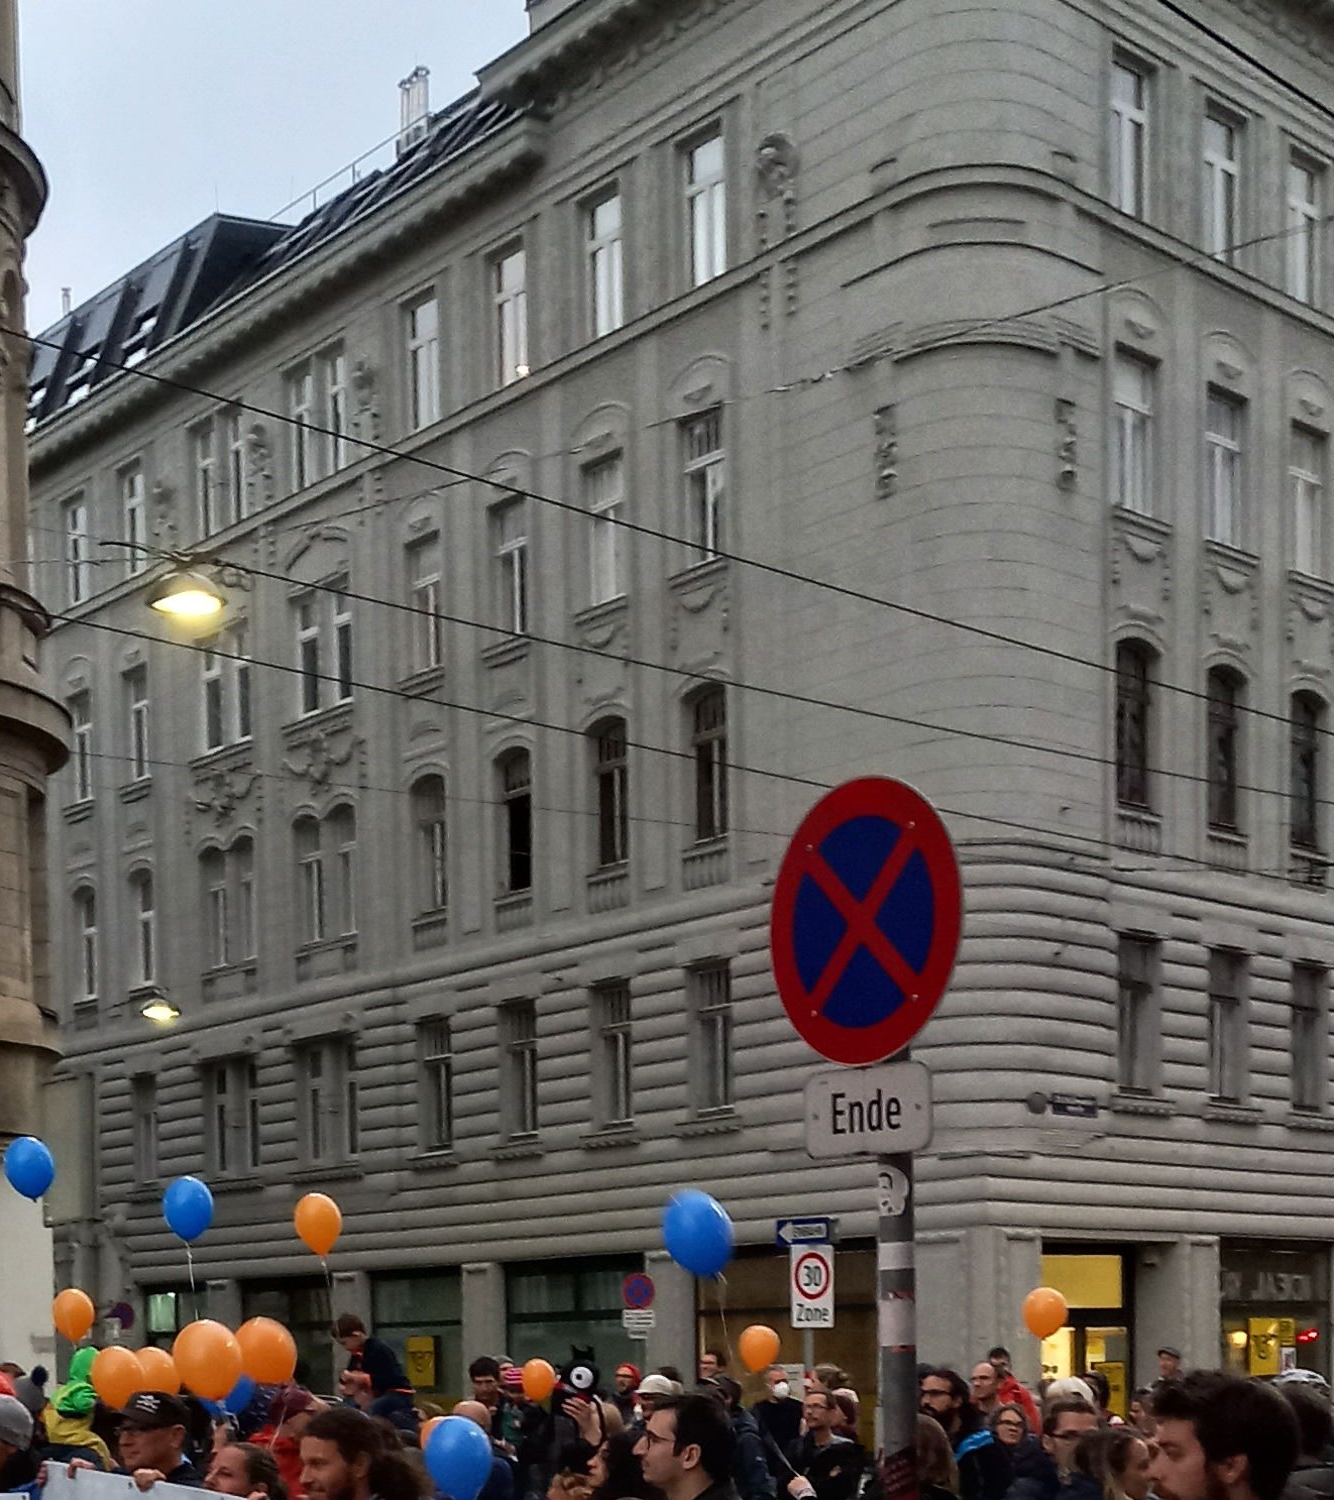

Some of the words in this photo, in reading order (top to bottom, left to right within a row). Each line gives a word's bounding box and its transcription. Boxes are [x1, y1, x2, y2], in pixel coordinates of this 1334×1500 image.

[831, 1087, 902, 1136] Ende
[802, 1264, 823, 1288] 30
[796, 1302, 830, 1323] Zone
